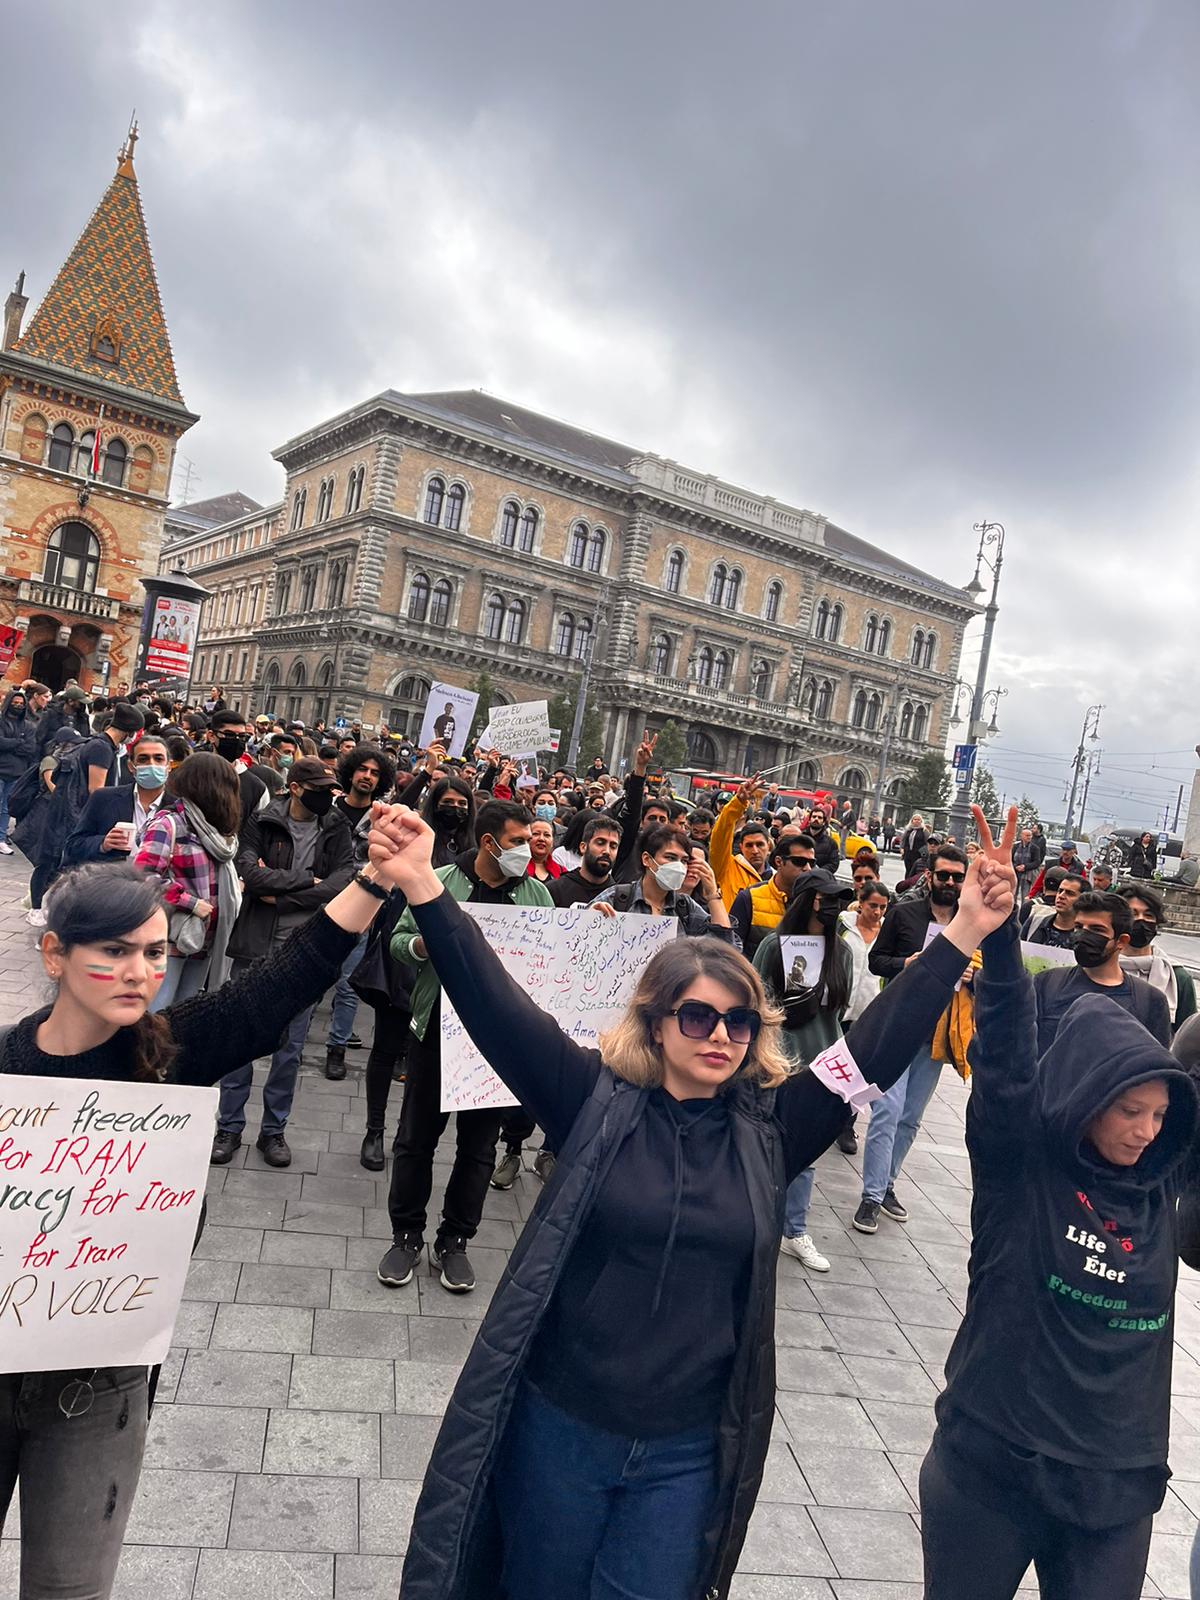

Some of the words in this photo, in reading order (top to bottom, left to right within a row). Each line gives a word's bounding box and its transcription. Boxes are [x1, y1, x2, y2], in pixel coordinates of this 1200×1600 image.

[491, 718, 510, 729] STOP
[511, 706, 521, 714] EU
[493, 728, 539, 743] MURDEROUS
[0, 1101, 60, 1132] ant
[72, 1091, 191, 1134] freedom
[0, 1137, 33, 1171] for
[40, 1136, 147, 1176] IRAN
[0, 1183, 75, 1234] racy
[80, 1178, 129, 1217] for
[136, 1181, 196, 1211] Iran
[22, 1233, 59, 1268] for
[65, 1237, 128, 1270] Iran
[1065, 1225, 1107, 1253] Life
[1083, 1255, 1127, 1283] Élet
[49, 1274, 159, 1320] VOICE
[1048, 1274, 1128, 1310] Freedom
[1108, 1311, 1170, 1331] Szabad
